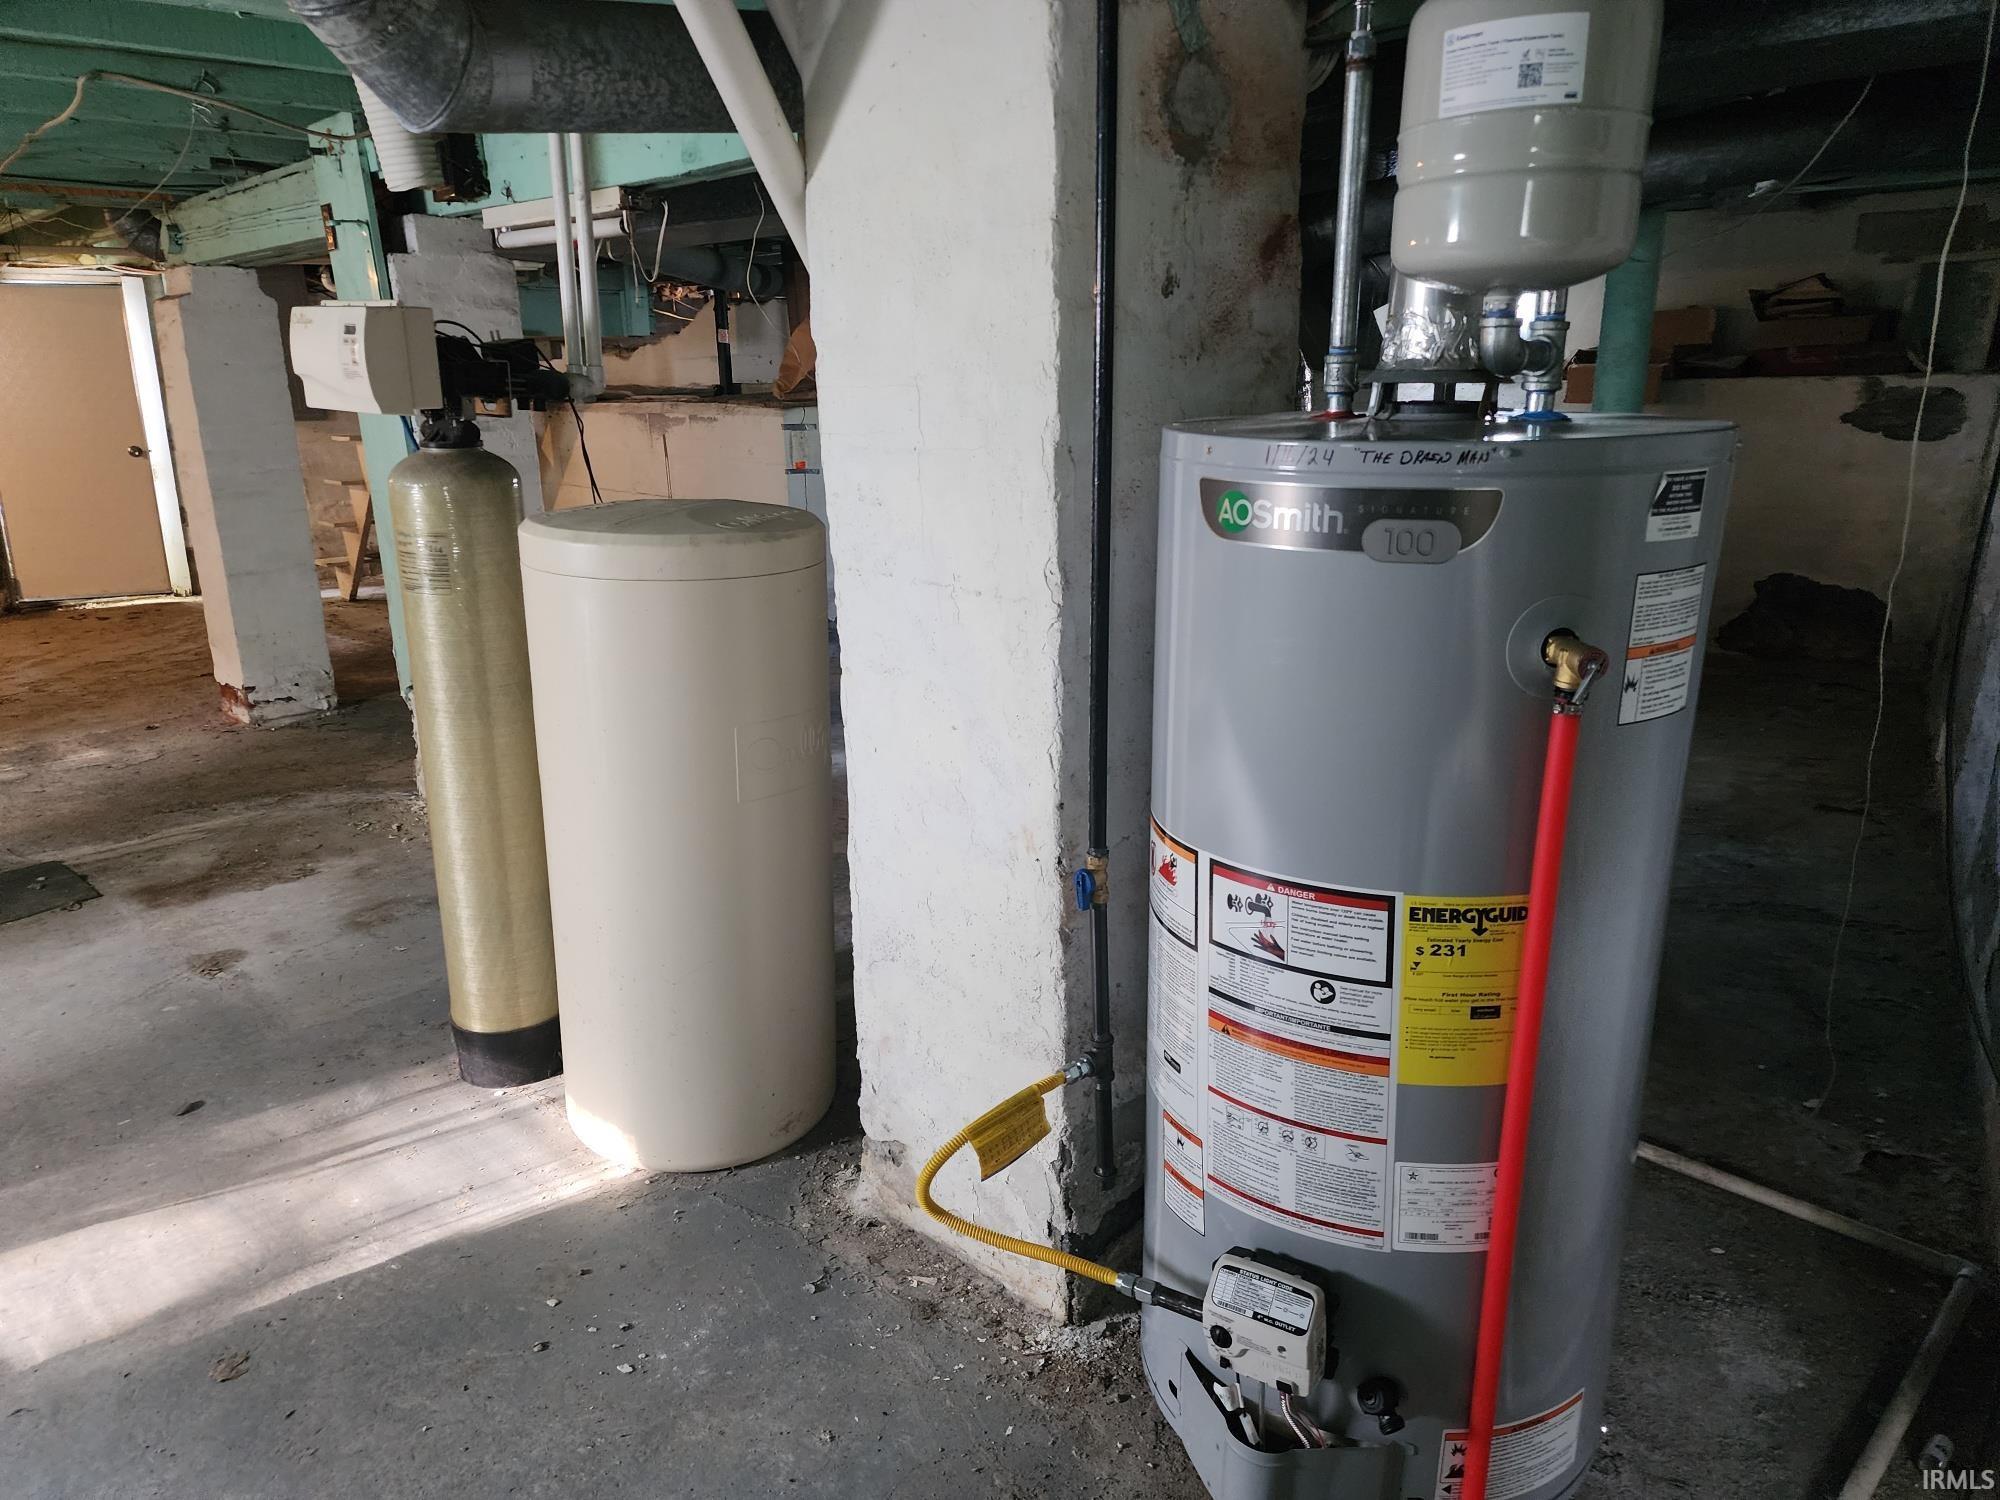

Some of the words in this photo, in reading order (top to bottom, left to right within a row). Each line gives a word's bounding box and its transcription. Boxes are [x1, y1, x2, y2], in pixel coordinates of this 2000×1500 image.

[1384, 528, 1436, 557] 100
[1277, 886, 1316, 900] DANGER
[1409, 906, 1528, 924] ENERGYGUID
[1416, 946, 1424, 956] $
[1430, 944, 1466, 956] 231
[1239, 1269, 1260, 1281] STATUS
[1260, 1276, 1277, 1286] LIGHT
[1278, 1282, 1293, 1292] CODE
[1274, 1320, 1296, 1332] OUTLET
